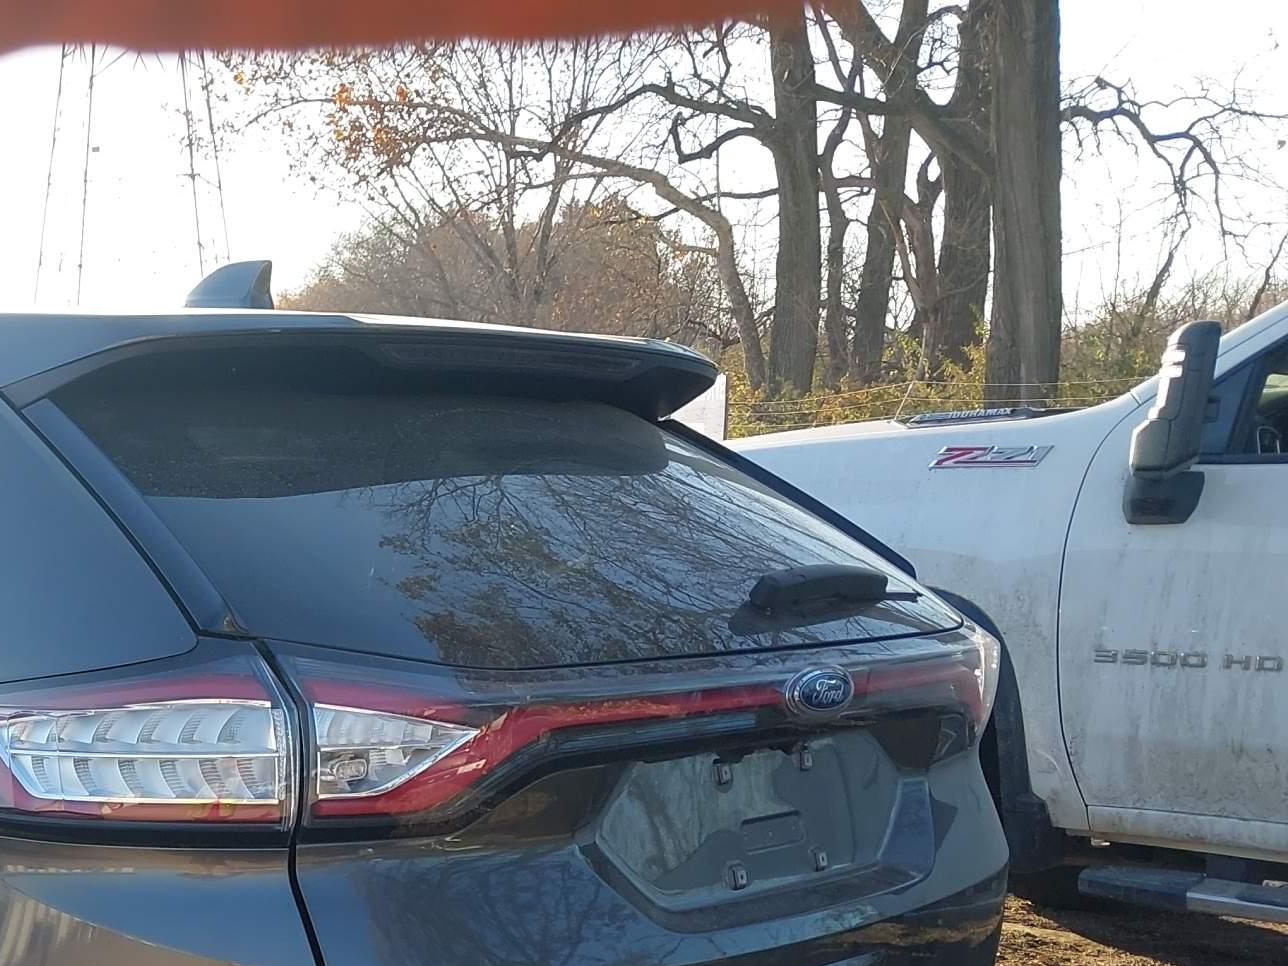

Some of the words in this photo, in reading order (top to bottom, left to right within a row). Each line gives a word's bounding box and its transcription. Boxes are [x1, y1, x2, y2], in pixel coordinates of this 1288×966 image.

[928, 445, 1054, 469] Z71
[1094, 648, 1207, 668] 3500
[1223, 653, 1283, 672] HD
